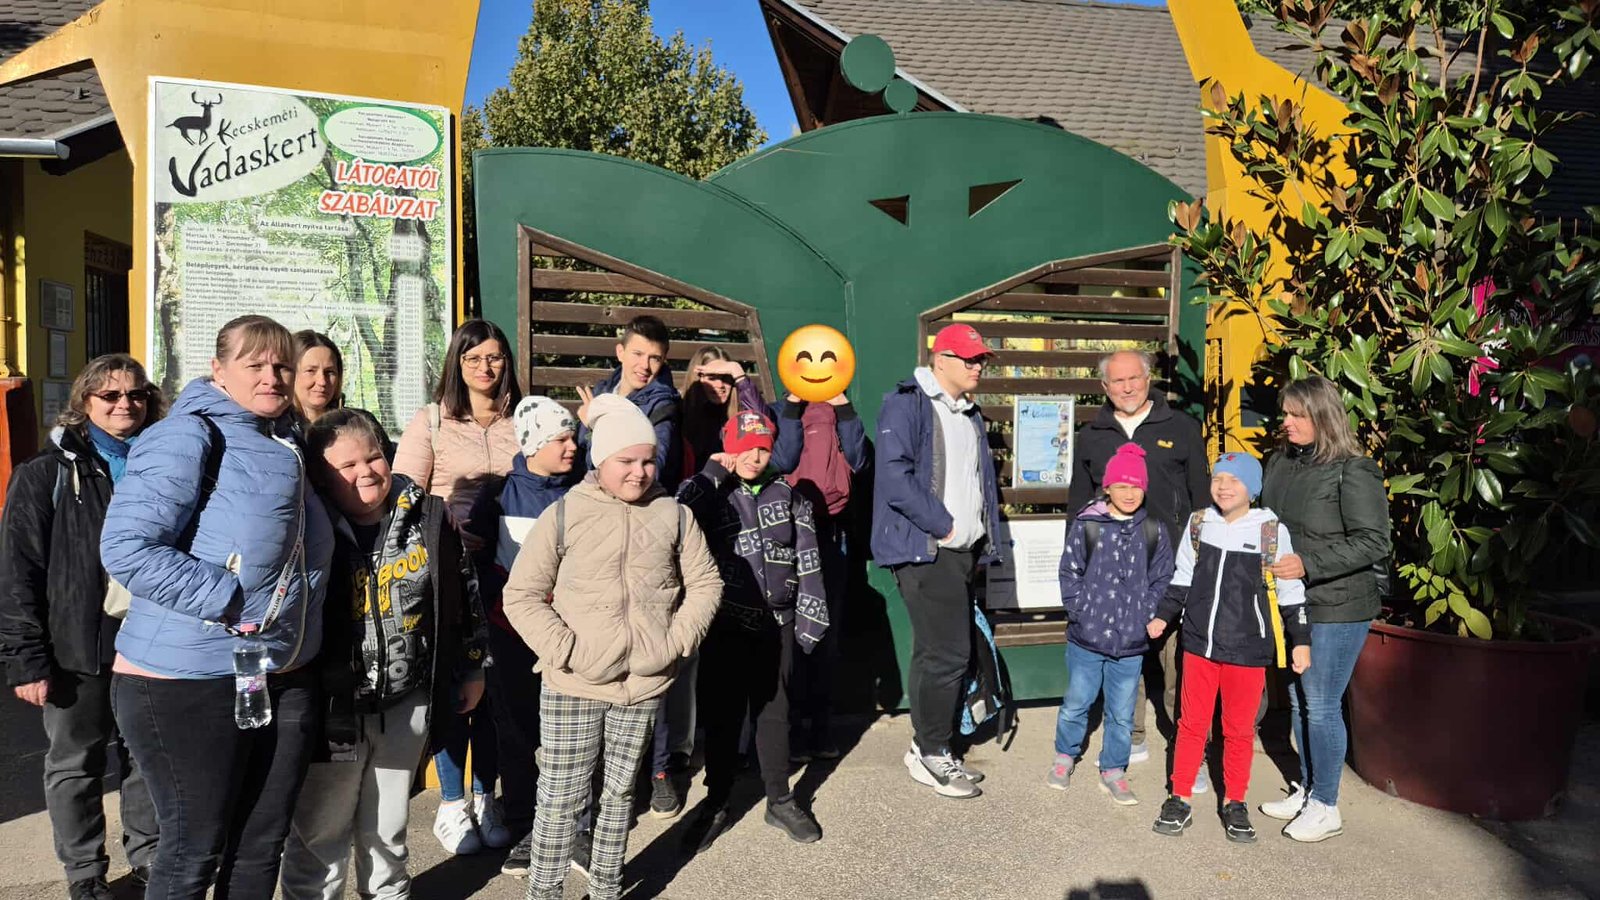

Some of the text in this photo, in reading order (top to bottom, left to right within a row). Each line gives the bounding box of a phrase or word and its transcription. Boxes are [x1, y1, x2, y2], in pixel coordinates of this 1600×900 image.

[216, 106, 298, 147] Kecskeméti
[168, 127, 318, 197] Vadaskert
[336, 160, 439, 189] LÁTOGATÓI
[320, 191, 439, 219] SZABÁLYZAT
